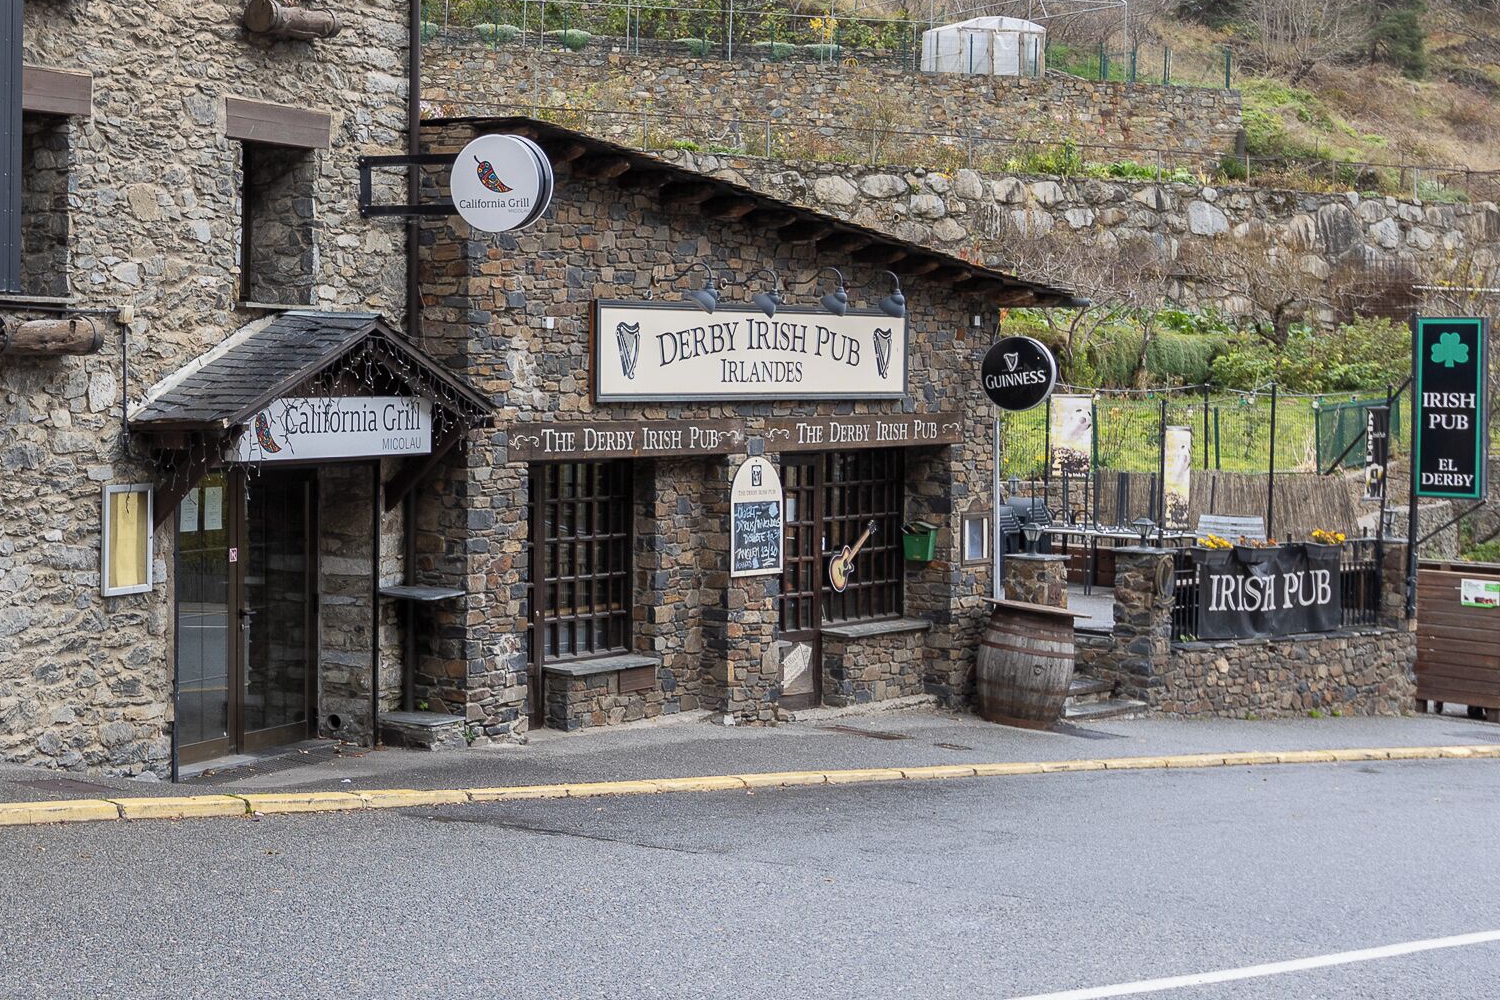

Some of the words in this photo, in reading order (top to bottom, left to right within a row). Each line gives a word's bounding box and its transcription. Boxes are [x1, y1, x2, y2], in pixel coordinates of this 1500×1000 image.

[460, 198, 506, 209] California
[508, 198, 529, 208] Grill
[656, 321, 739, 367] DERBY
[746, 318, 808, 354] IRISH
[815, 325, 861, 367] PUB
[721, 358, 803, 383] IRLANDES
[985, 369, 1046, 390] GUINNESS
[1422, 392, 1476, 409] IRISH
[285, 403, 378, 435] California
[382, 402, 421, 432] Grill
[1428, 413, 1469, 430] PUB
[541, 428, 575, 453] THE
[583, 427, 635, 452] DERBY
[642, 427, 682, 450] IRISH
[689, 426, 719, 449] PUB
[796, 423, 823, 444] THE
[829, 422, 870, 443] DERBY
[876, 420, 908, 441] IRISH
[914, 419, 938, 440] PUB
[382, 437, 421, 450] MICOLAU
[1438, 458, 1458, 471] EL
[1421, 472, 1474, 487] DERBY
[1208, 574, 1277, 612] IRISH
[1282, 569, 1332, 609] PUB
